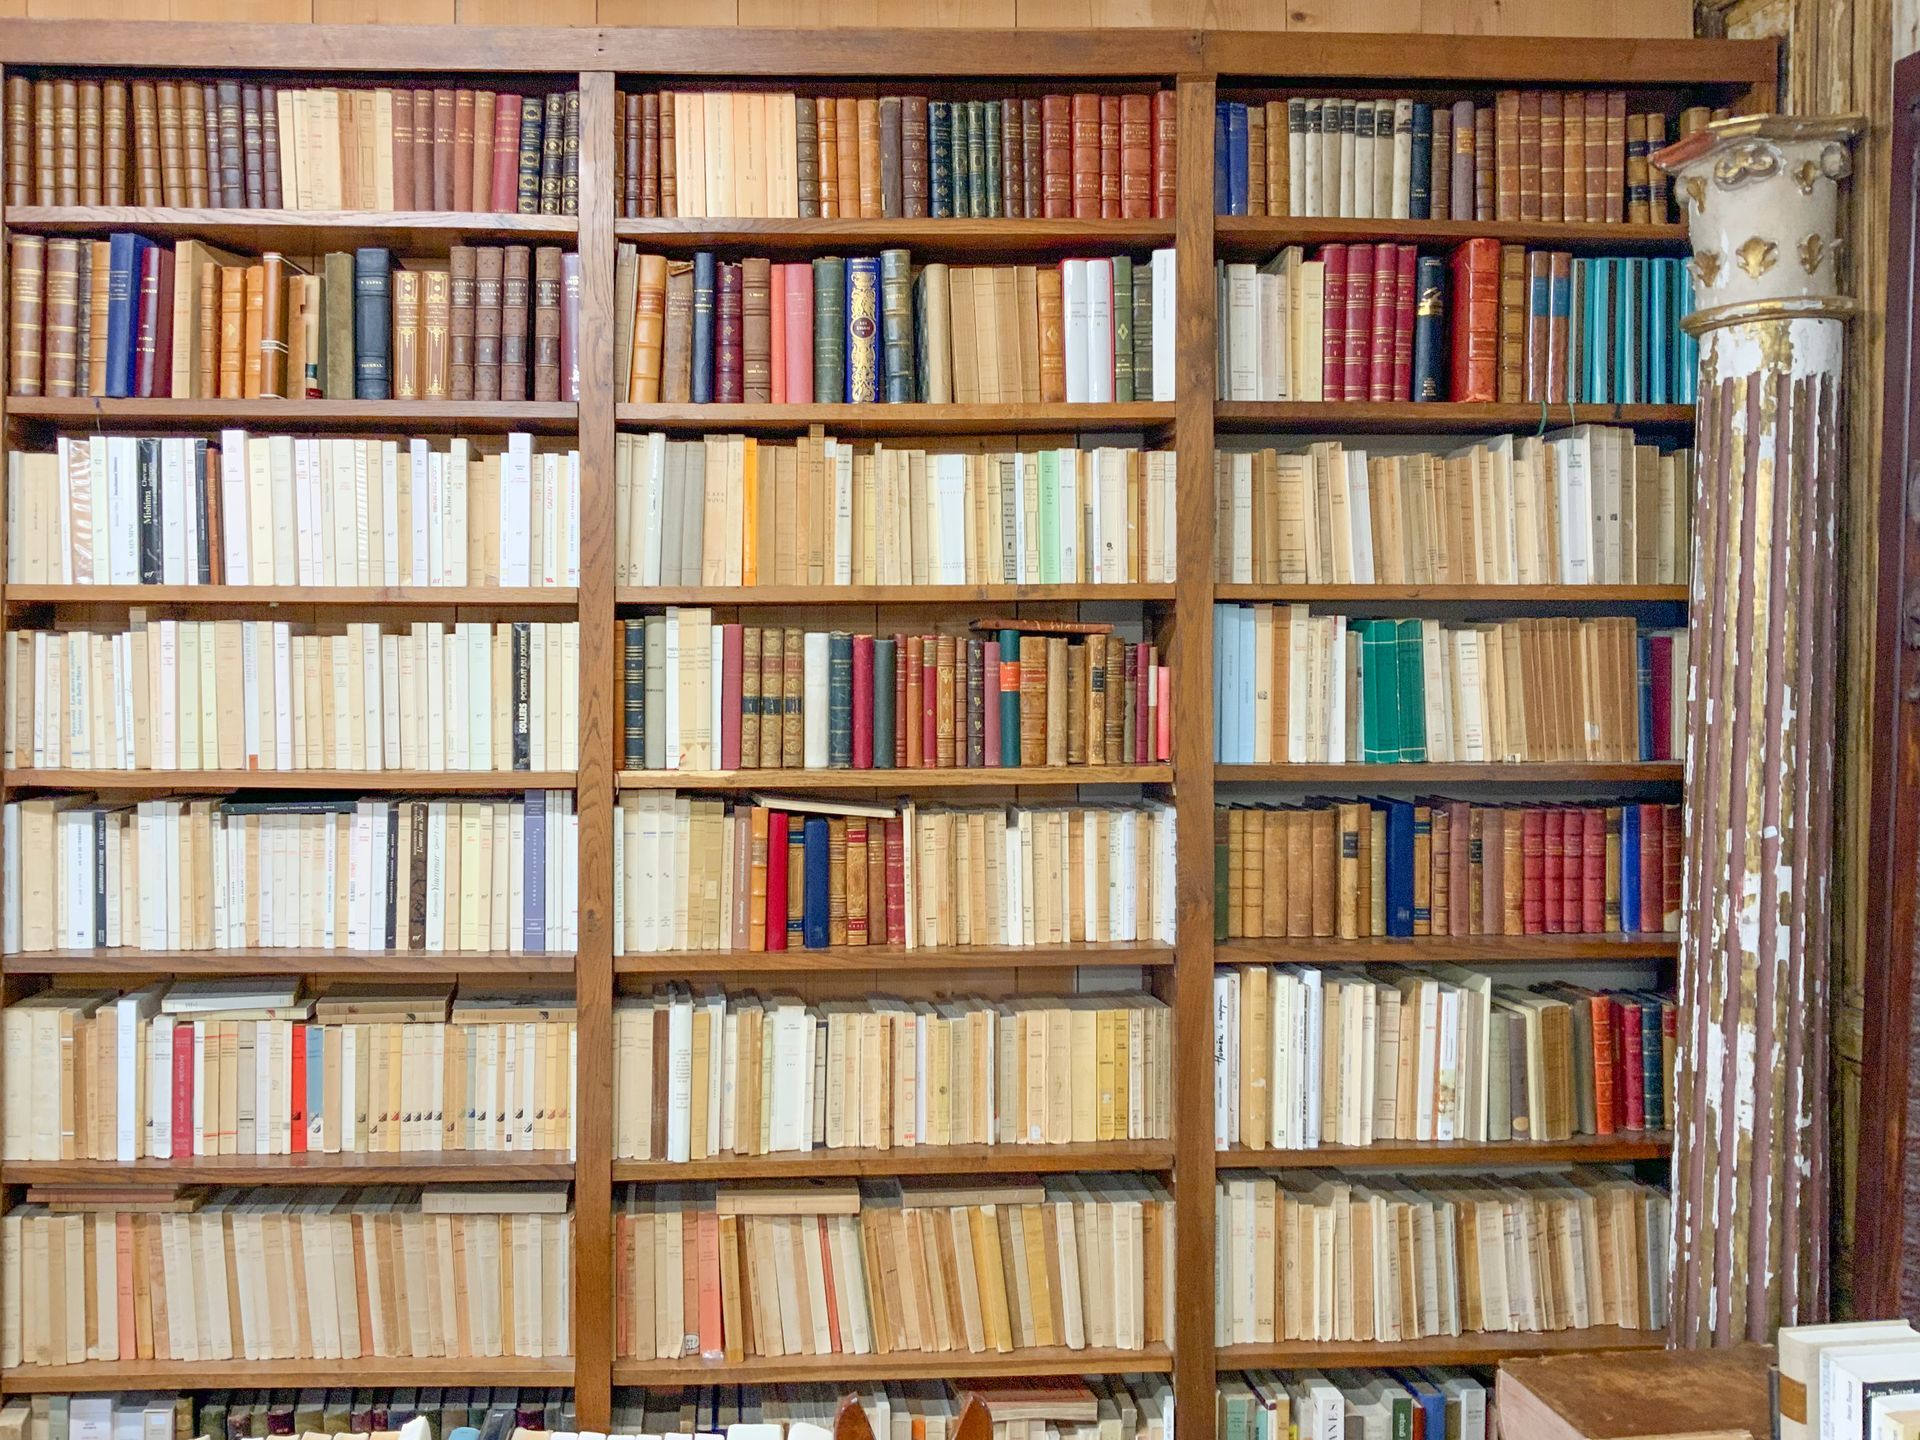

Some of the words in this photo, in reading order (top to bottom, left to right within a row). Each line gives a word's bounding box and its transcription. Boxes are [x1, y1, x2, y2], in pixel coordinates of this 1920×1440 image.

[143, 490, 152, 525] Mishima
[520, 657, 527, 667] DU
[519, 703, 528, 733] SOLLERS
